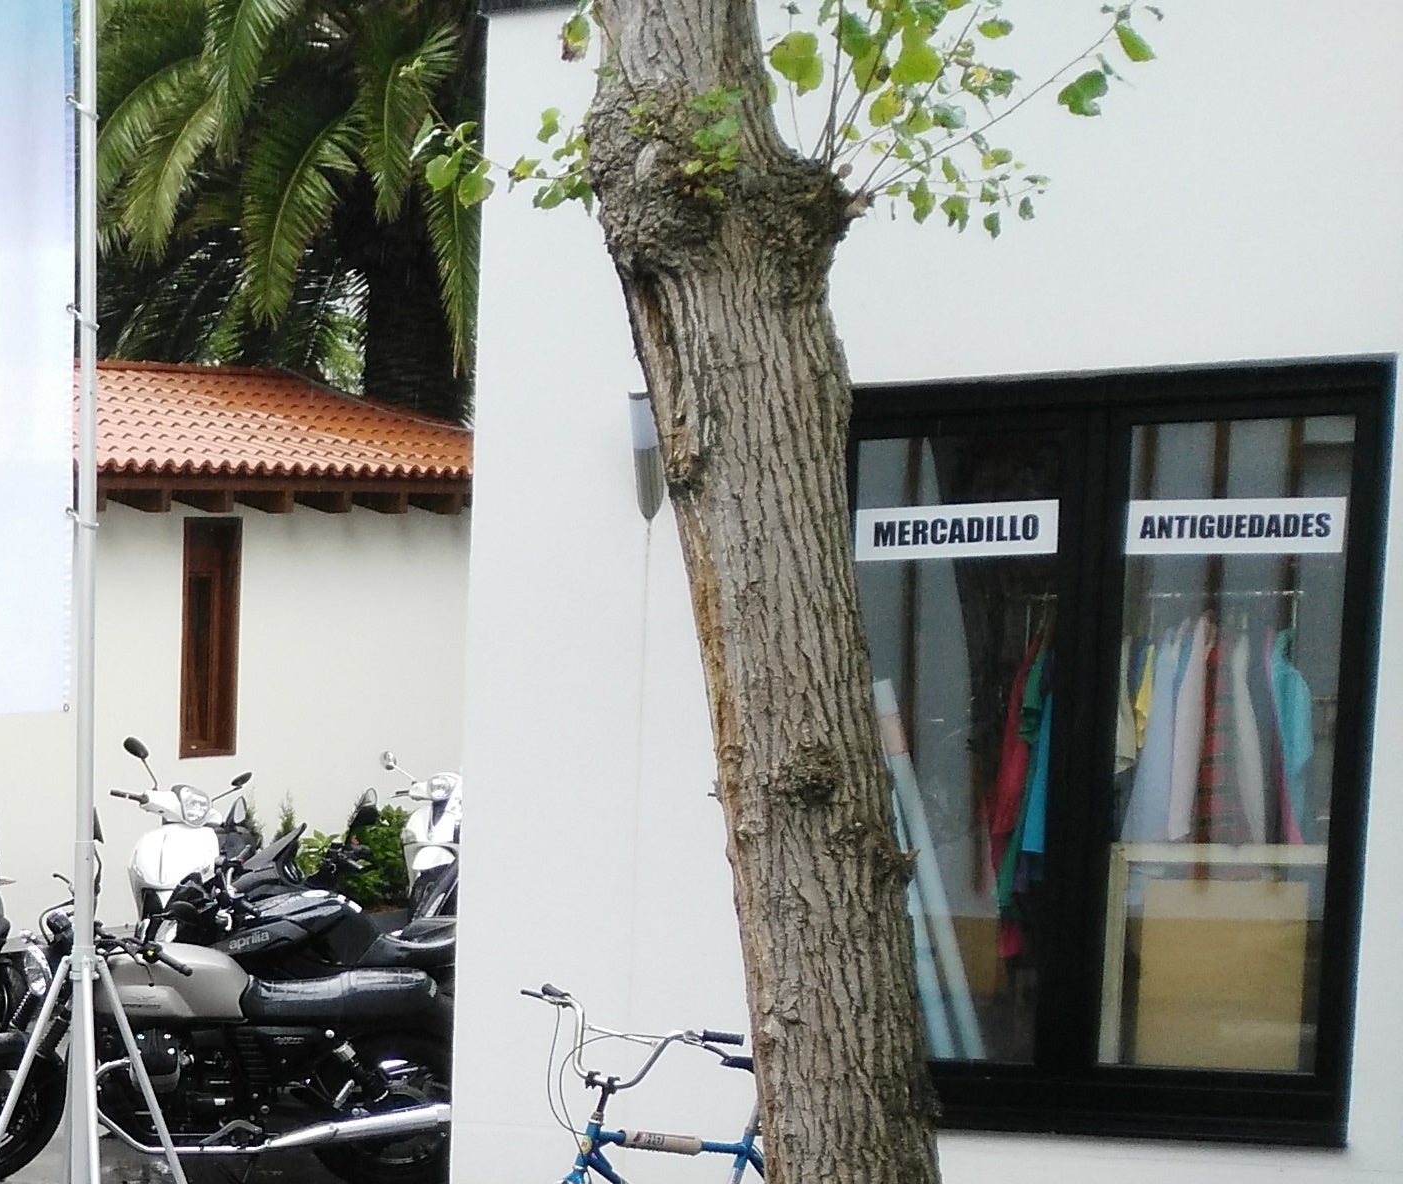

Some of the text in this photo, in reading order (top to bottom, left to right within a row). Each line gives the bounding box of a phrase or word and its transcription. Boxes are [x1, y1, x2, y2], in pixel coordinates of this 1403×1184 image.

[872, 513, 1040, 548] MERCADILLO
[1139, 511, 1332, 540] ANTIGUEDADES
[229, 930, 270, 951] aprilia
